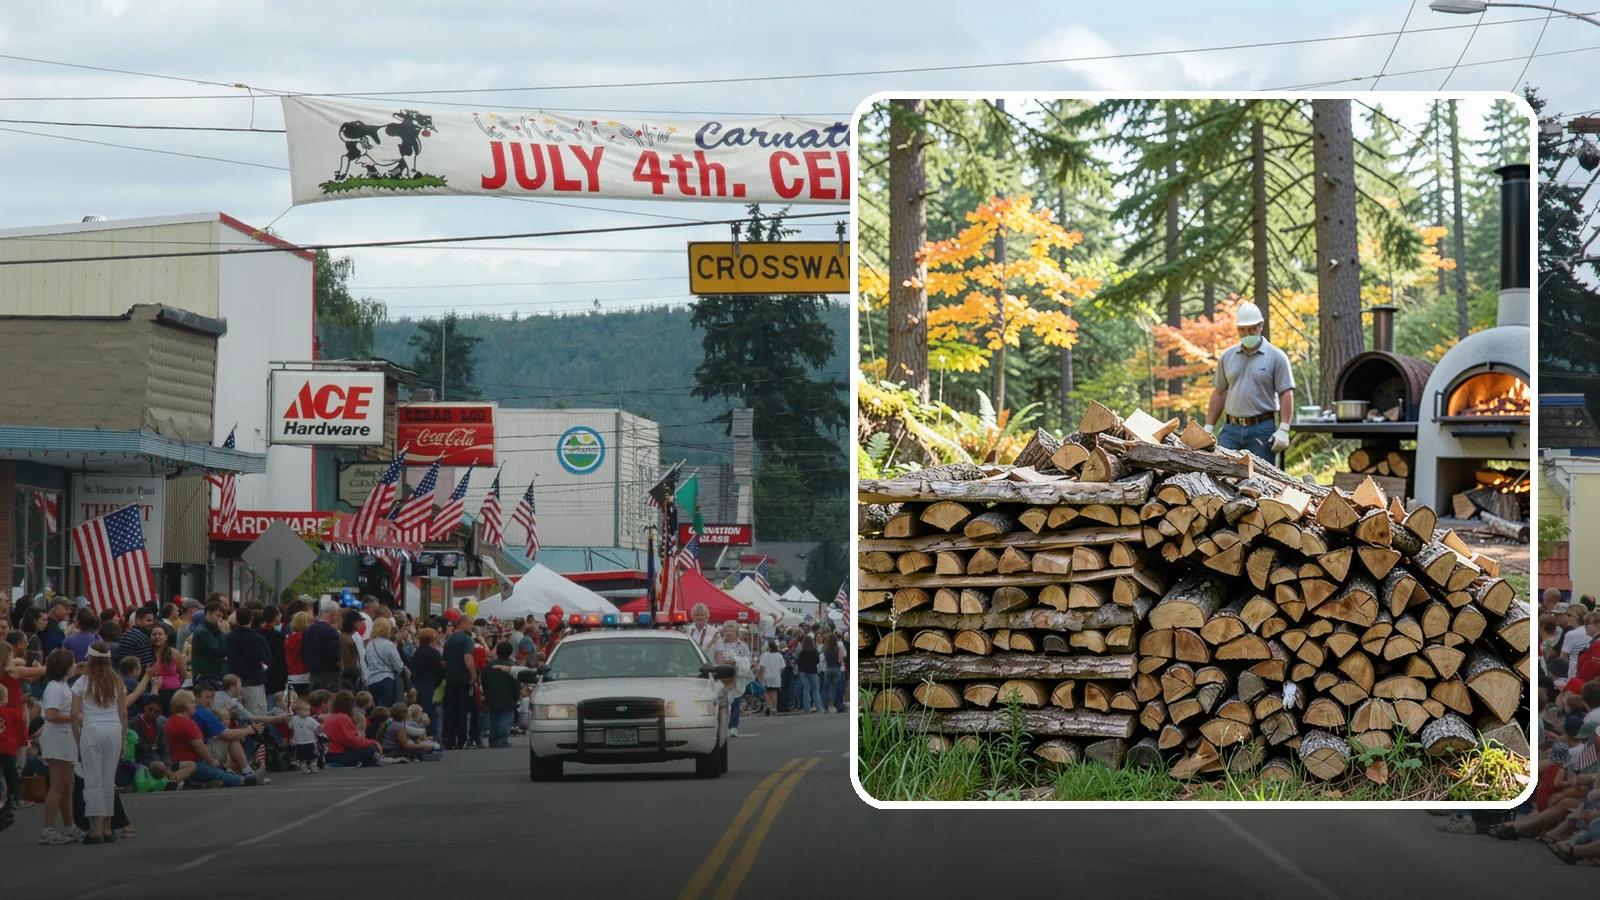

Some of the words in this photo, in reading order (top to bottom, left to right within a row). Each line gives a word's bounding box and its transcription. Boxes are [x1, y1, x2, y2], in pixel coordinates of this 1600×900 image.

[481, 140, 605, 192] JULY
[632, 150, 746, 198] 4th.
[697, 254, 850, 280] CROSSWA
[283, 380, 373, 420] ACE
[405, 409, 453, 423] CEDAR
[461, 409, 485, 423] LOG
[283, 421, 371, 437] Hardware
[83, 485, 93, 495] St.
[95, 485, 124, 495] Vincent
[126, 485, 136, 495] de
[137, 485, 155, 496] Paul
[688, 526, 741, 535] CRNATION
[699, 535, 730, 544] GLASS
